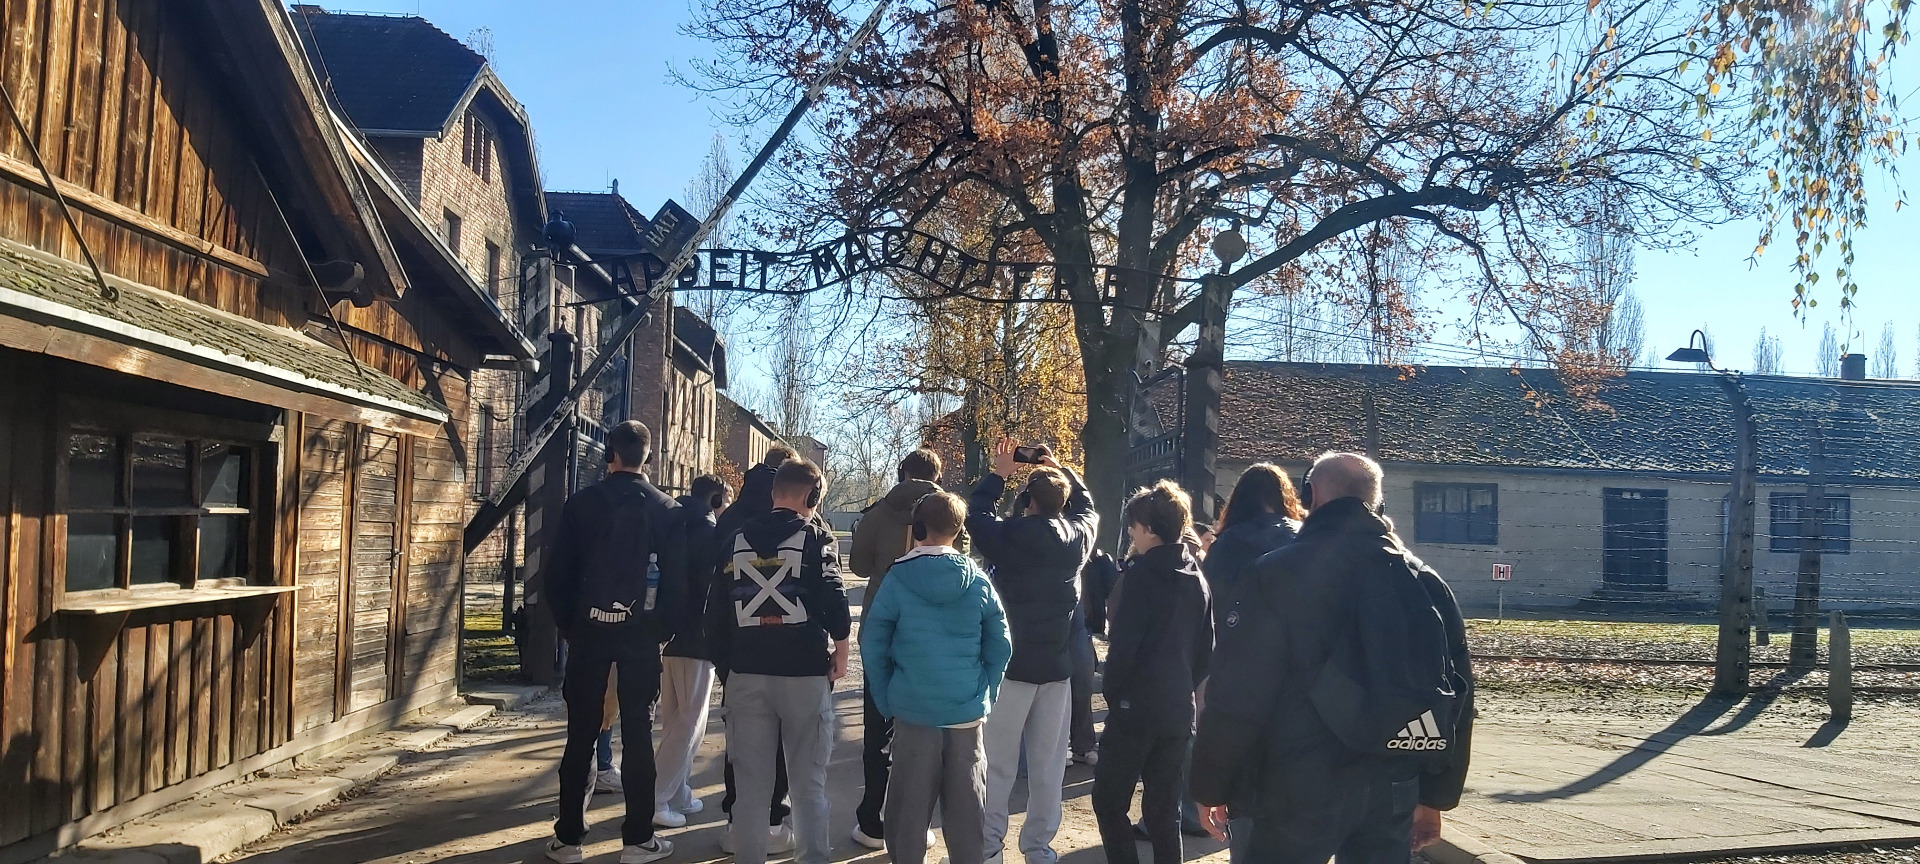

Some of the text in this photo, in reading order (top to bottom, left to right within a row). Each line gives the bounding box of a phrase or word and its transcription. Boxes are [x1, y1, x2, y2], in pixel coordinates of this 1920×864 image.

[645, 208, 679, 247] HALT
[611, 228, 1152, 313] ARBEIT MACHT FRE
[1498, 566, 1505, 579] H
[1386, 736, 1448, 751] adidas
